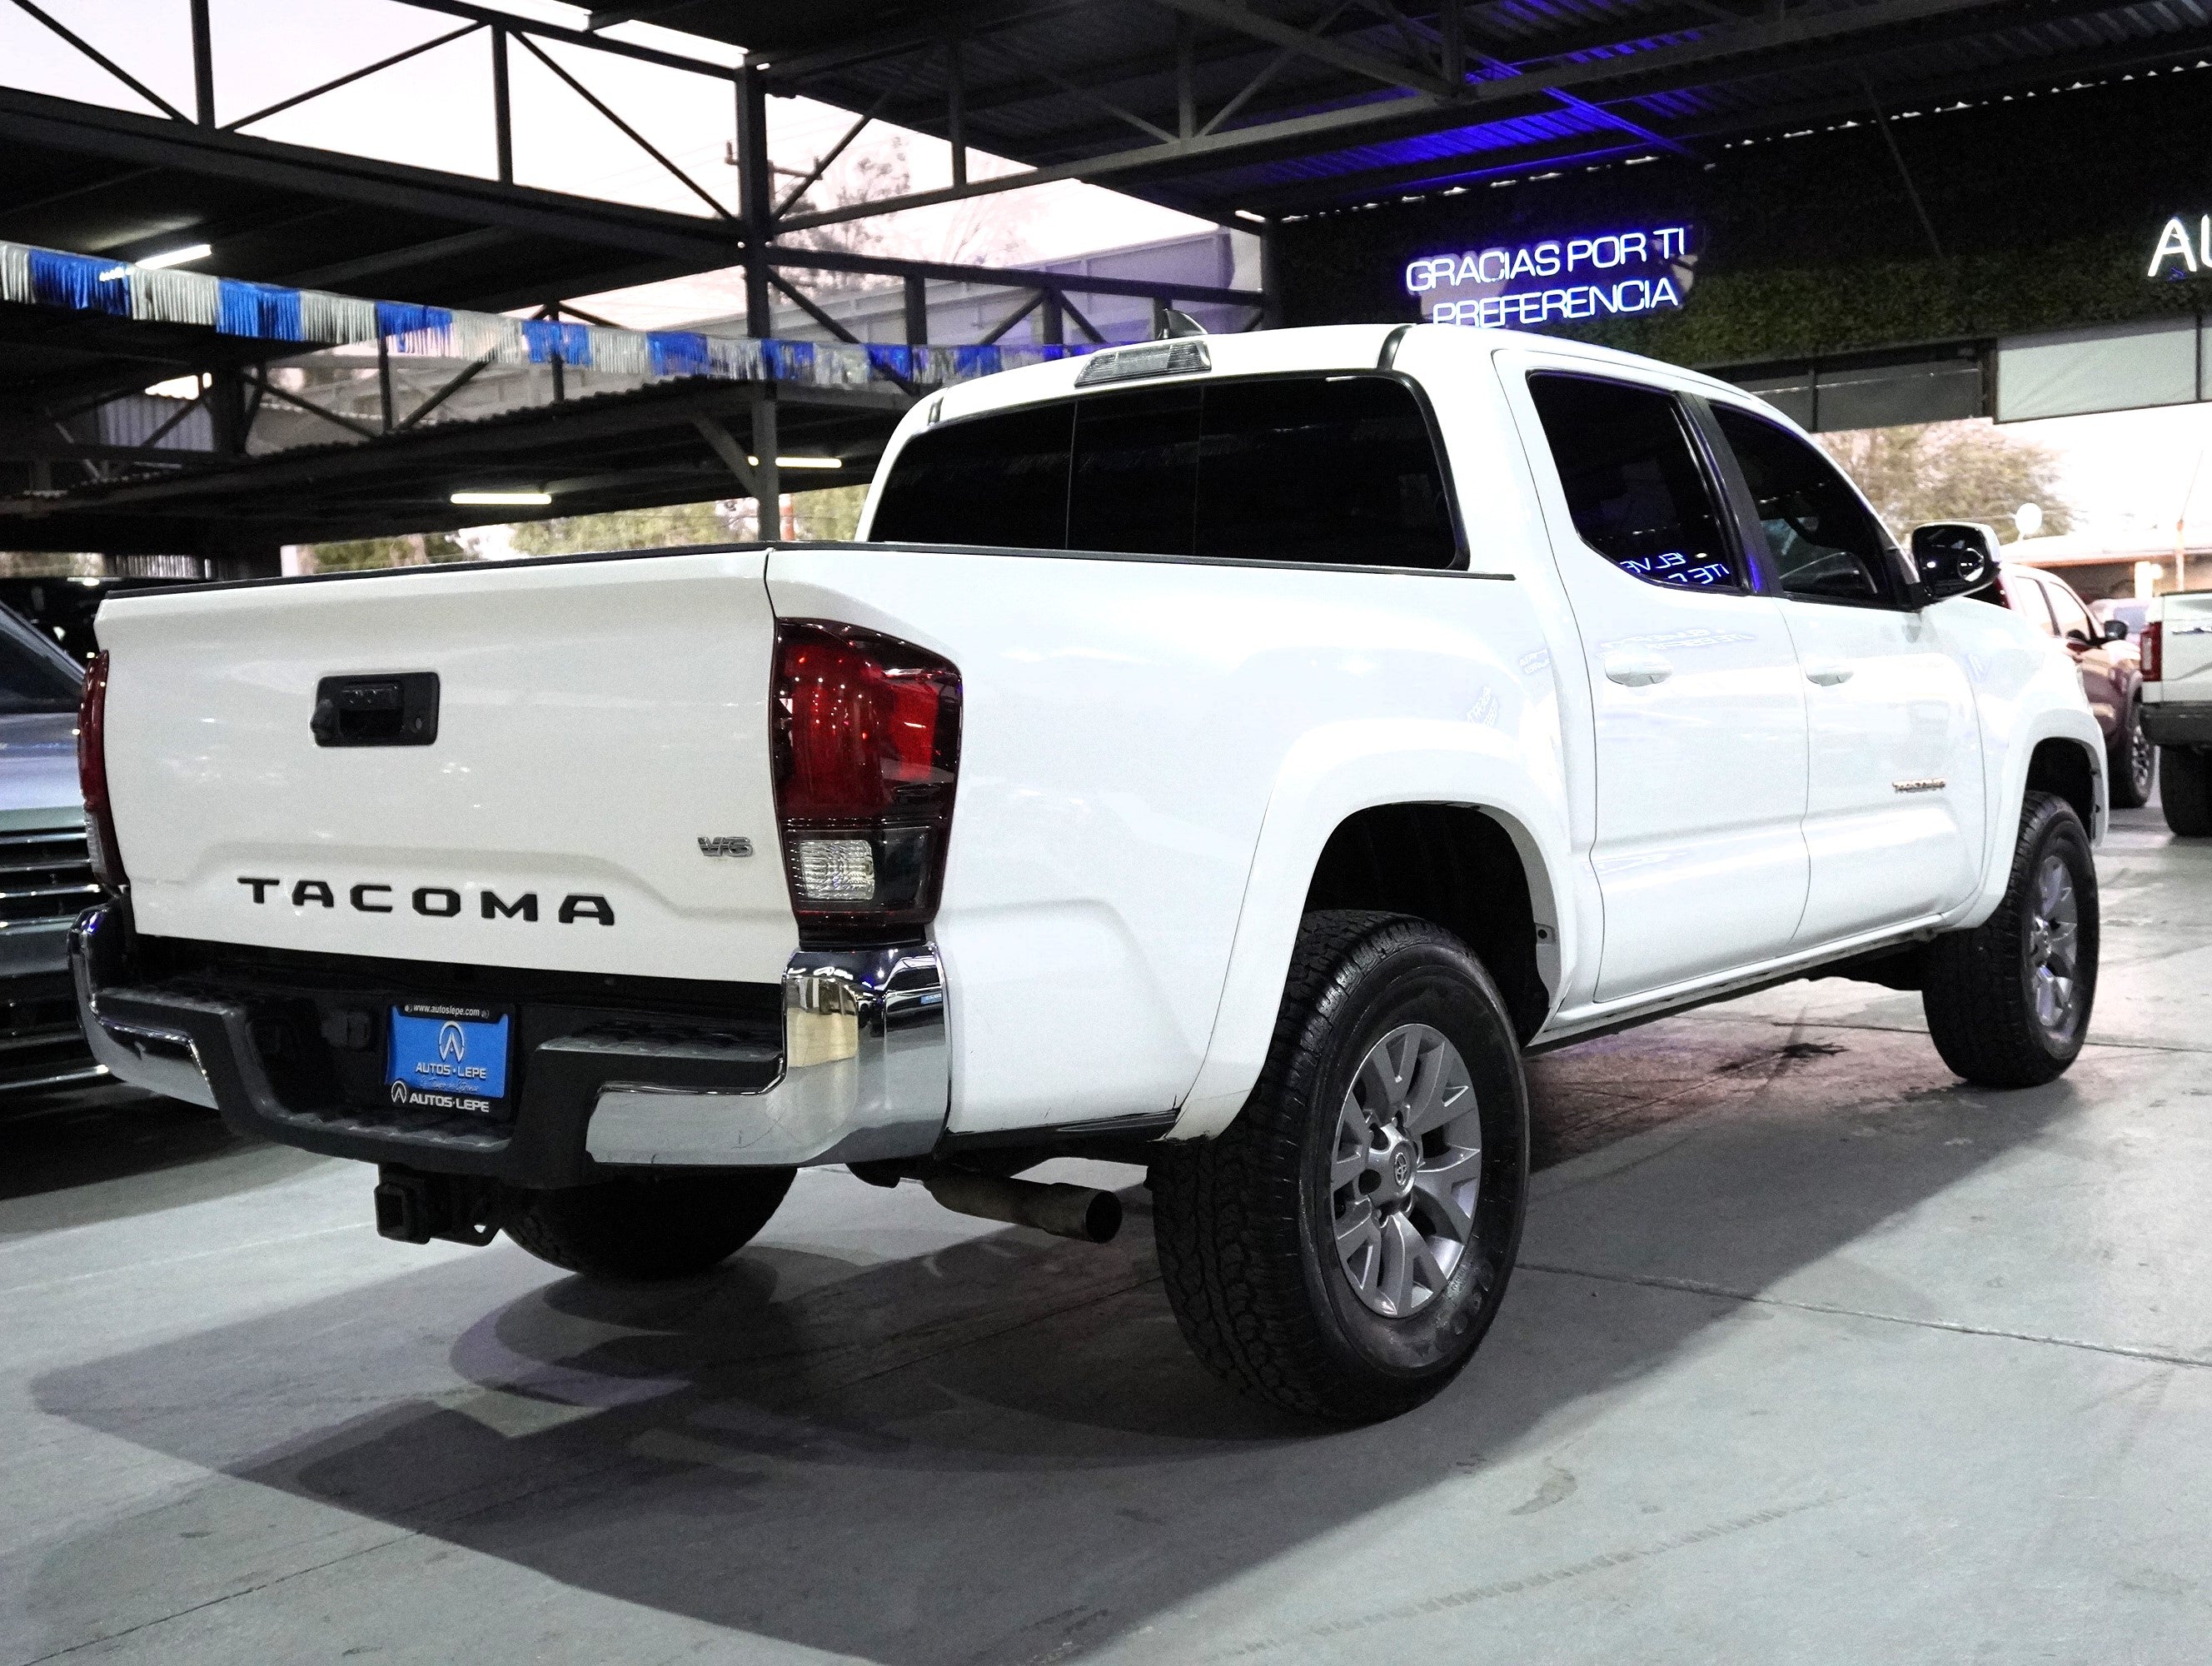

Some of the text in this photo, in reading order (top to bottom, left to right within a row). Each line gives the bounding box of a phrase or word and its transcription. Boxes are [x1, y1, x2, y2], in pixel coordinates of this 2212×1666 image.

[1406, 227, 1686, 292] GRACIAS POR TI
[1432, 277, 1678, 328] PREFERENCIA
[698, 836, 753, 857] V6
[237, 876, 615, 926] TACOMA
[413, 1004, 480, 1016] www.autoslepe.com
